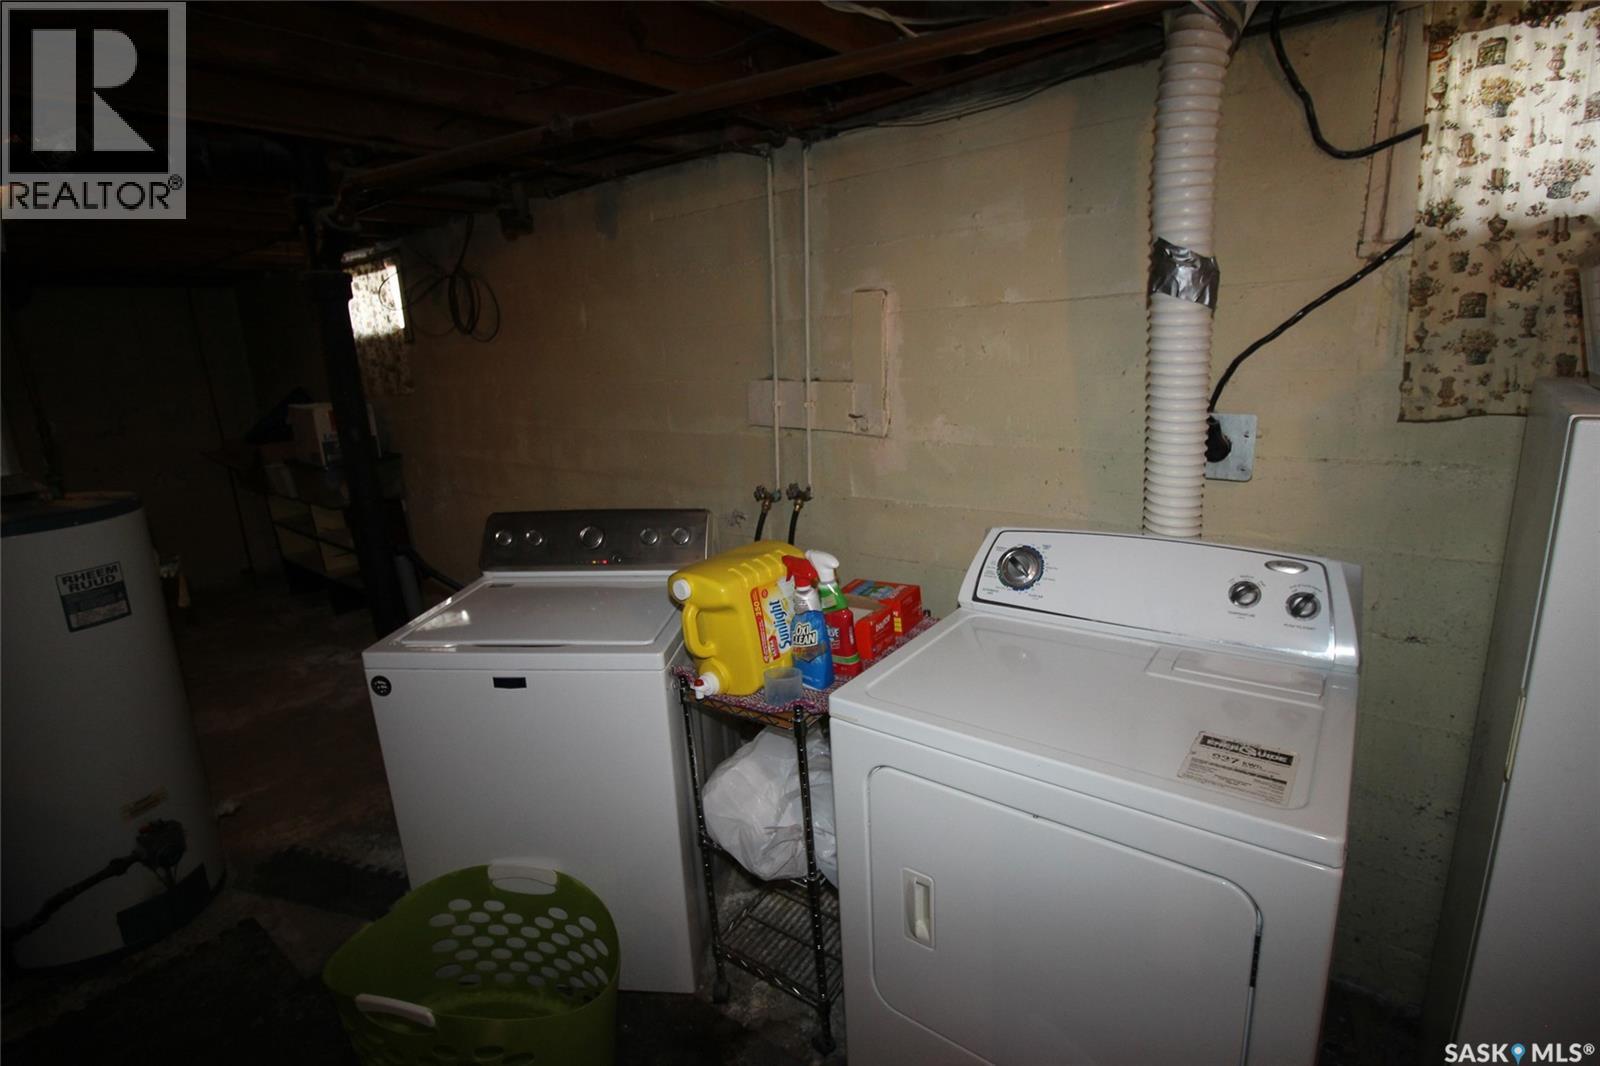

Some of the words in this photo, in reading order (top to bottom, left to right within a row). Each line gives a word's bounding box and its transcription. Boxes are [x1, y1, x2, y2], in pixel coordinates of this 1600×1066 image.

[62, 565, 118, 585] RHEEM
[69, 575, 116, 592] RUUD
[768, 600, 791, 650] Sunlight
[796, 623, 809, 636] OXI
